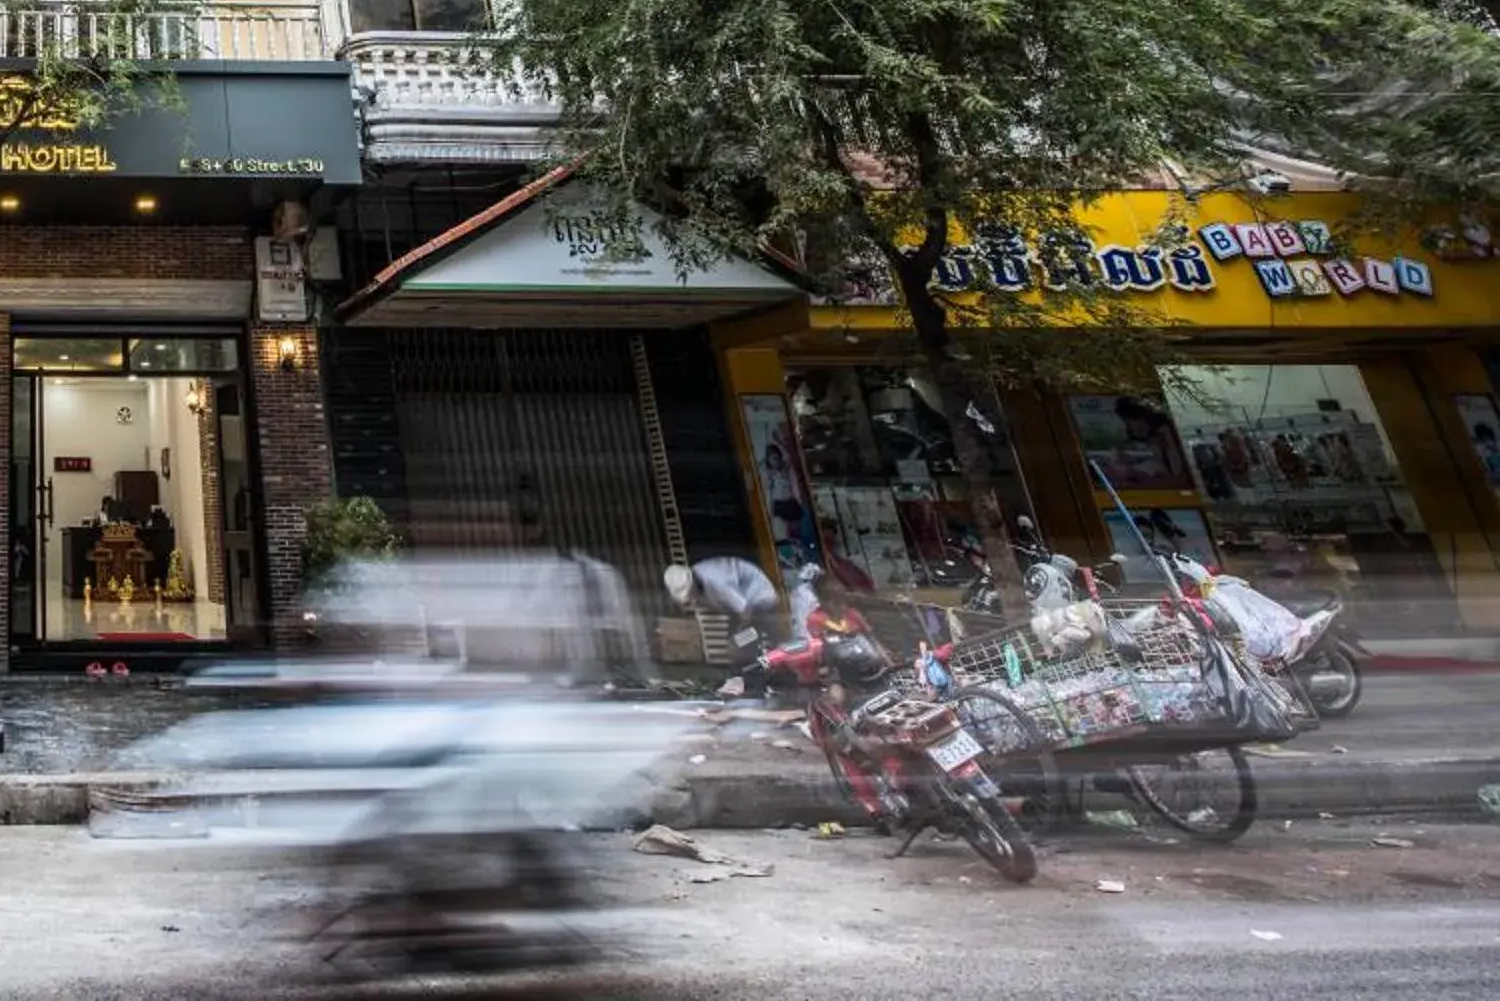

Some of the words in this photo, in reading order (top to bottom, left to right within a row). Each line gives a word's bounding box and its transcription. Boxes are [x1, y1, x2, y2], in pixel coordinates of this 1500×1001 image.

[1, 143, 117, 172] HOTEL
[1206, 225, 1328, 255] BABY
[1260, 262, 1427, 290] WORLD
